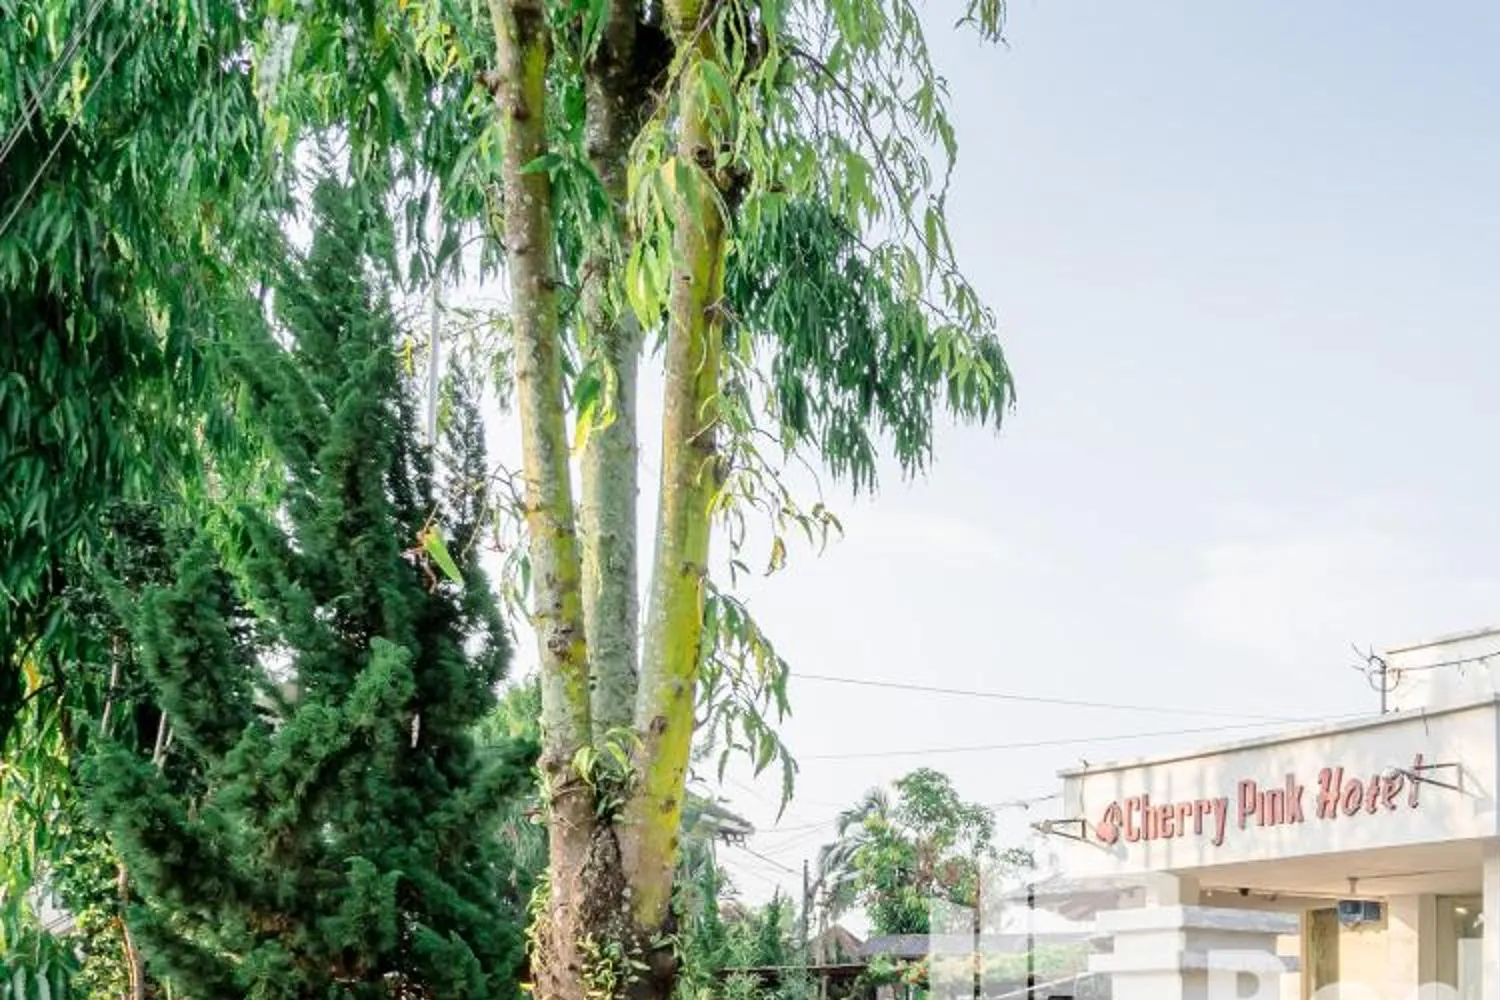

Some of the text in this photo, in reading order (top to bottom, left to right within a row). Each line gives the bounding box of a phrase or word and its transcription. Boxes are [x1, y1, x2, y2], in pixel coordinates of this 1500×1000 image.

[1122, 753, 1423, 846] Cherry Pink Hotel
